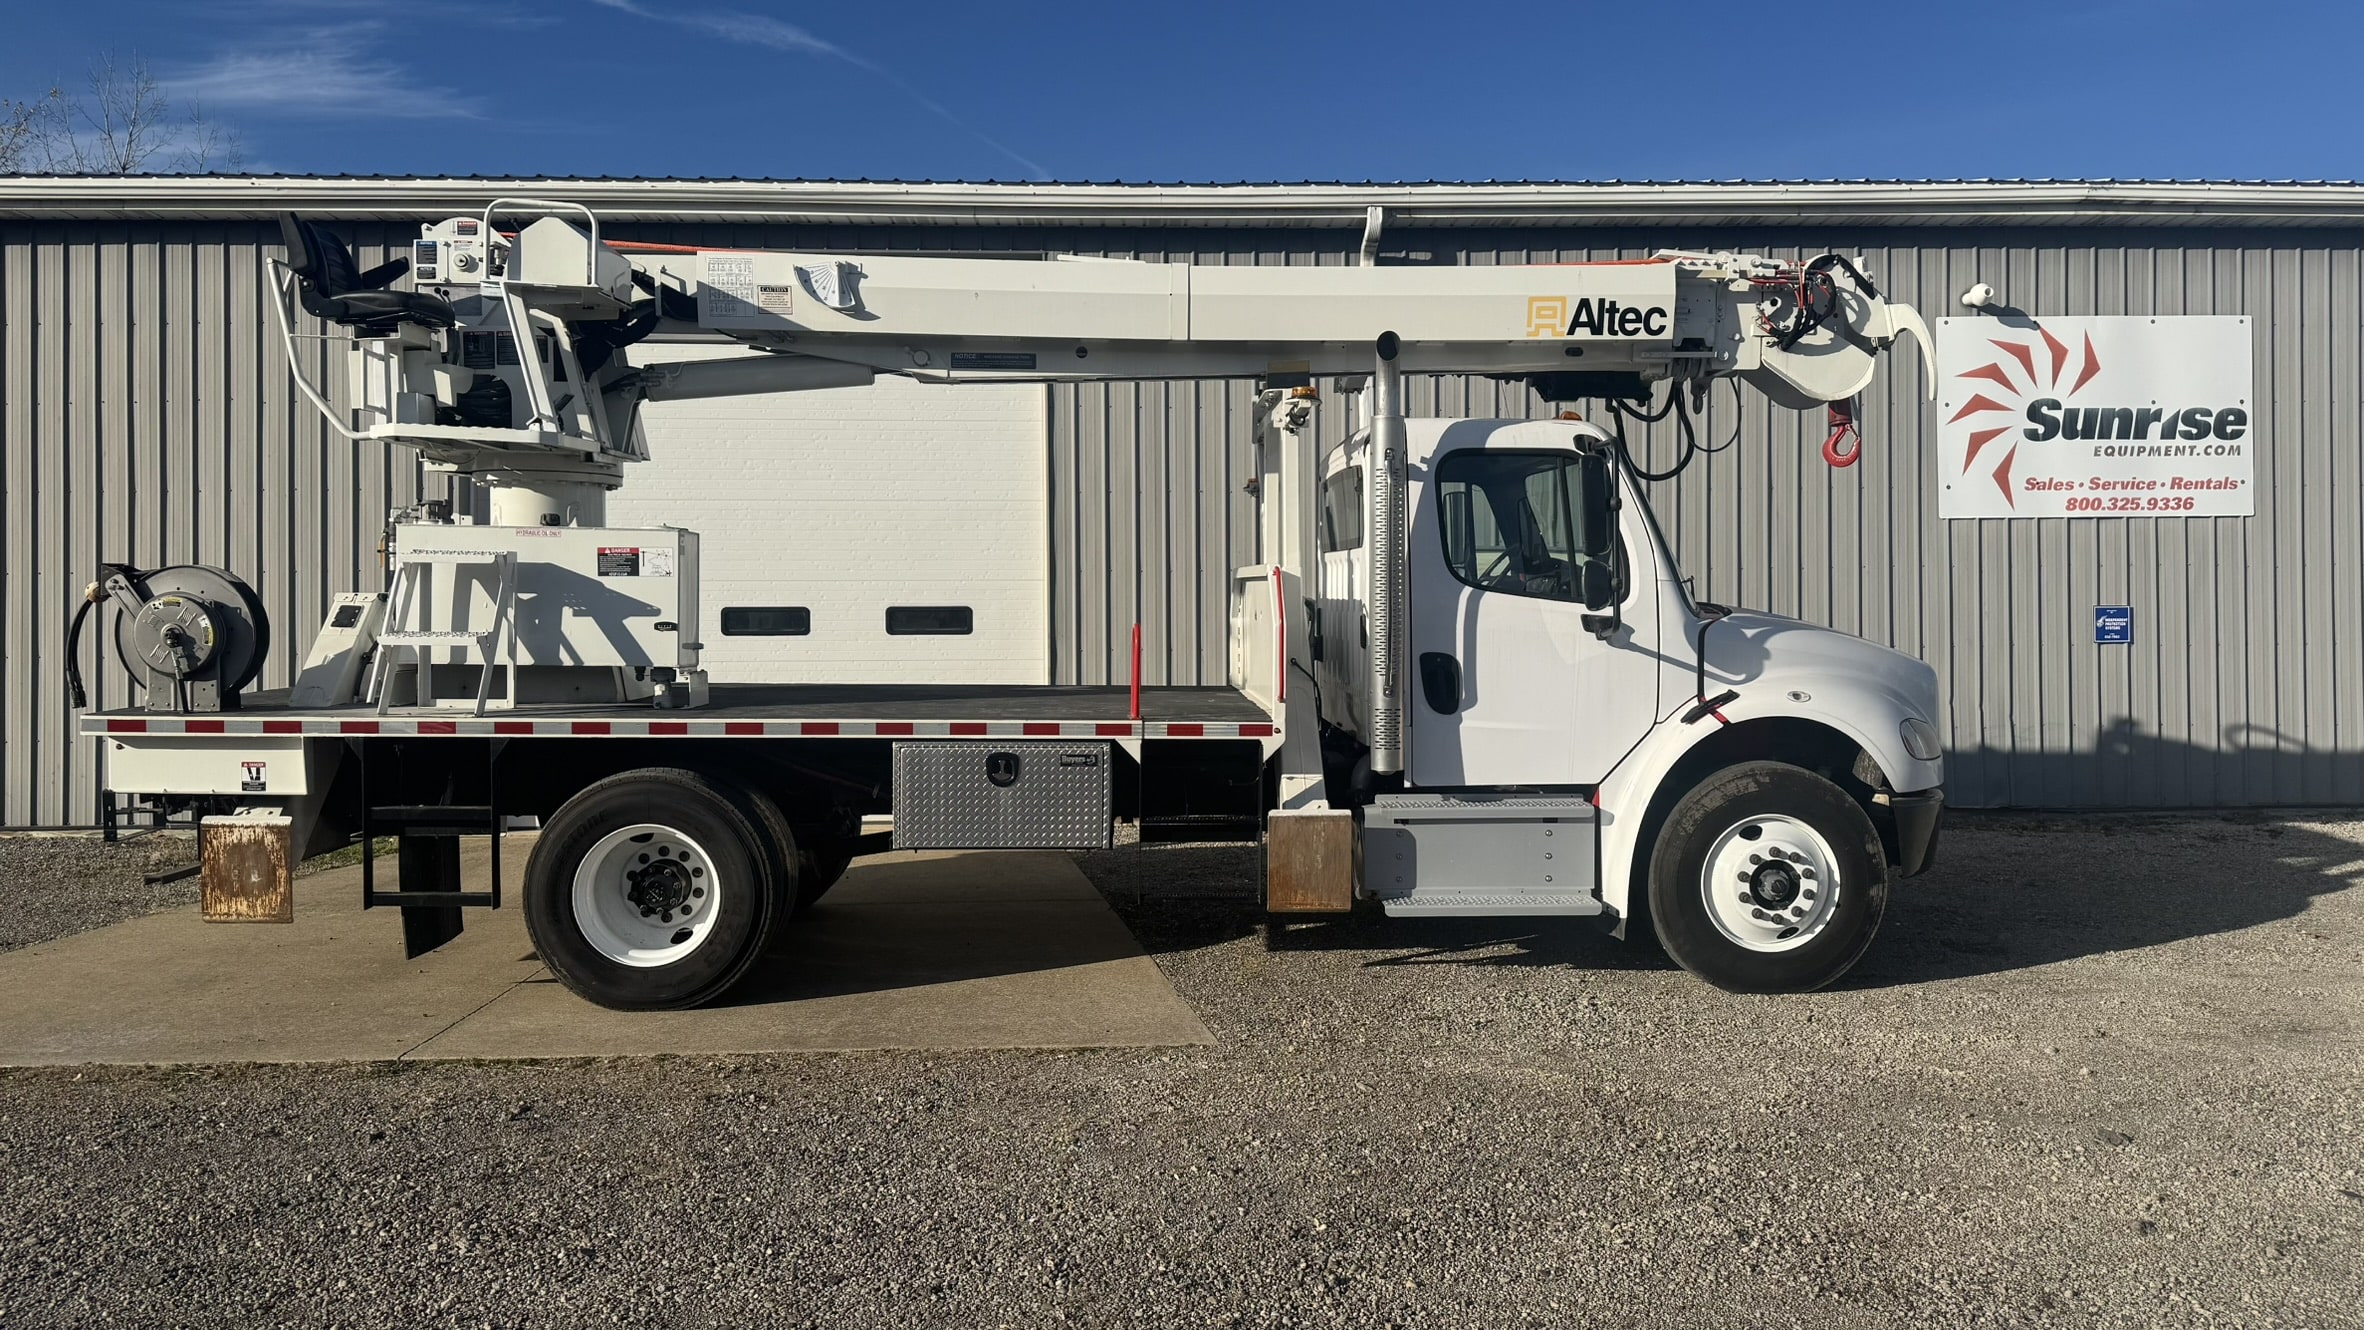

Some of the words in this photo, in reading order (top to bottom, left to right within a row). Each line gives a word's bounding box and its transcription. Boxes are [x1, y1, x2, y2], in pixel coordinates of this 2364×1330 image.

[1566, 298, 1668, 336] Altec
[2023, 398, 2248, 442] Sunrise
[2093, 445, 2242, 457] EQUIPMENT.COM
[2024, 477, 2075, 491] Sales
[2088, 477, 2157, 491] Service
[2169, 477, 2239, 491] Rentals
[2065, 497, 2195, 511] 800.325.9336
